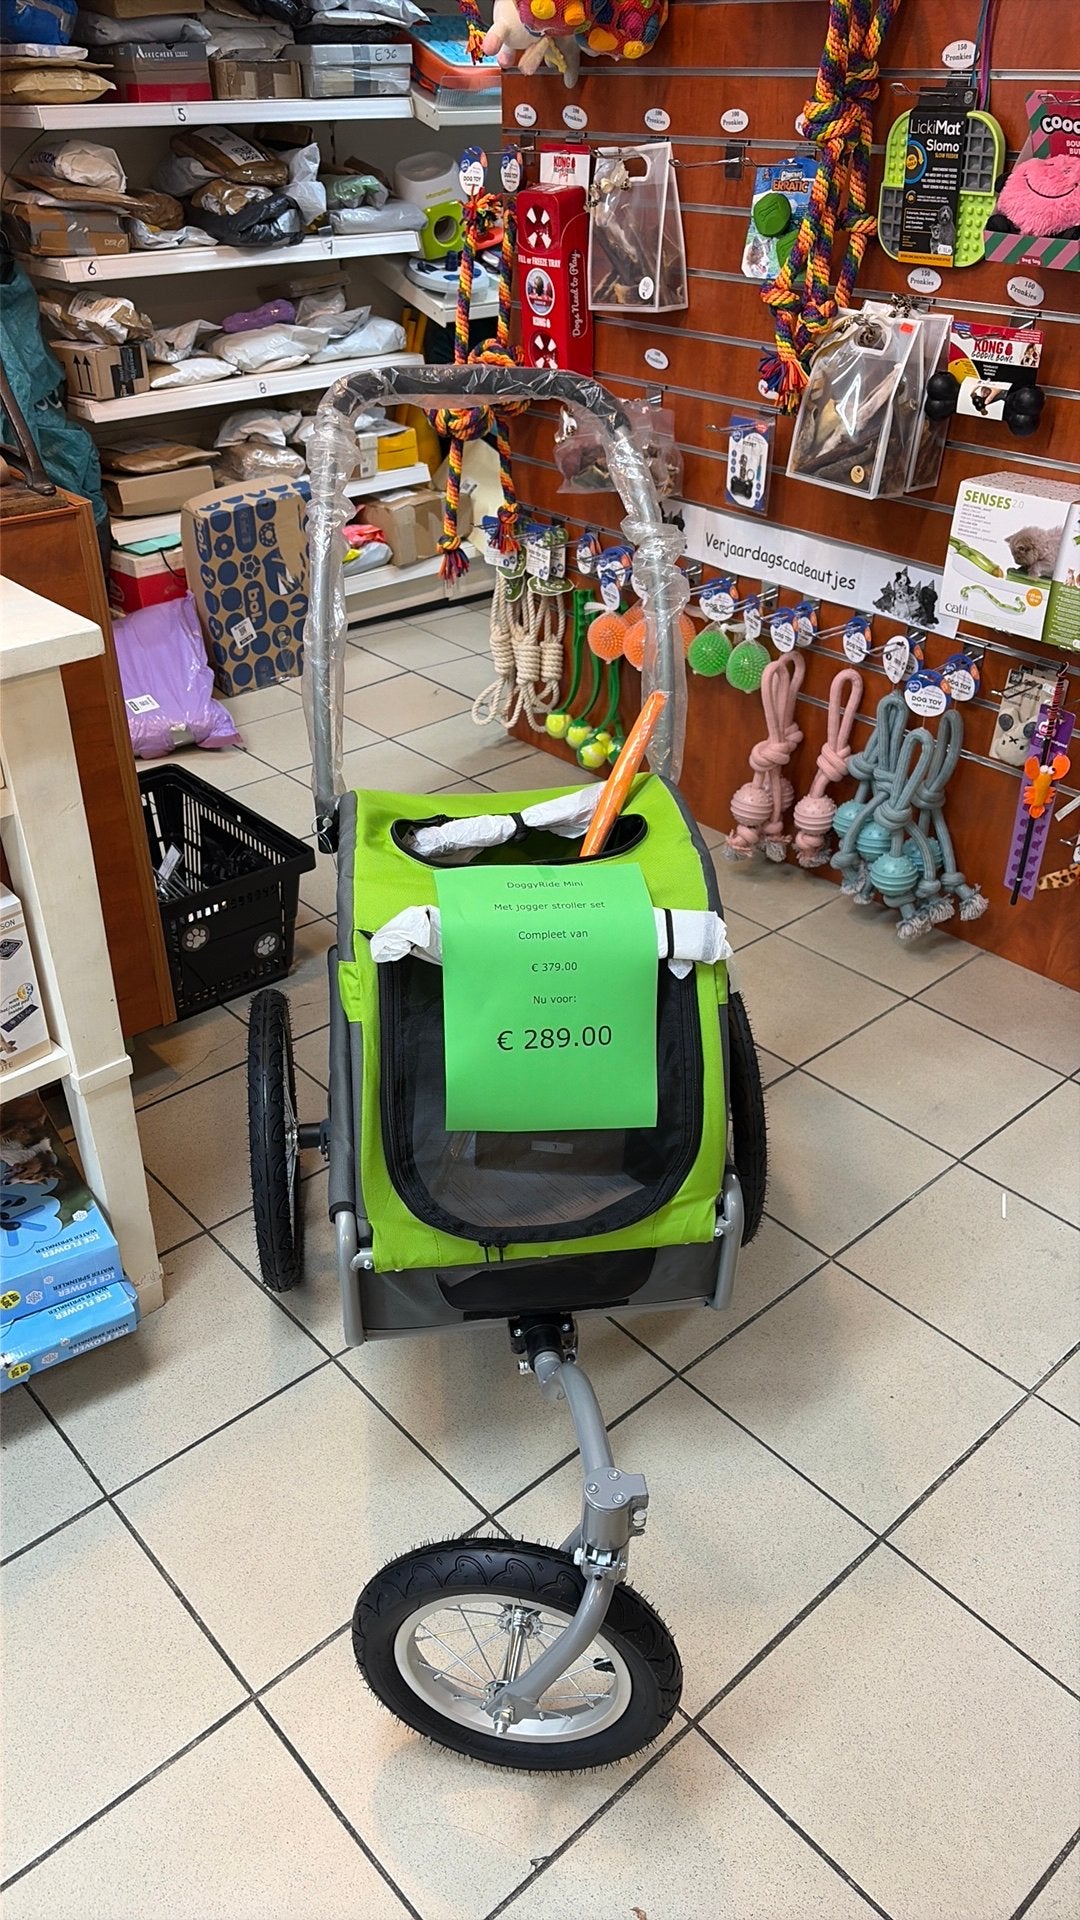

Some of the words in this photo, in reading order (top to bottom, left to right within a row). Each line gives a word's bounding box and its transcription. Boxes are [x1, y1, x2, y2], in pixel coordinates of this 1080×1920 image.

[375, 48, 397, 61] E36
[945, 53, 971, 61] Pronkies
[178, 107, 187, 122] 5
[647, 116, 665, 125] Pronkies
[910, 119, 961, 136] LickiMat
[926, 139, 959, 152] Slomo
[554, 156, 570, 168] KONG
[771, 179, 809, 193] ERRATIC
[324, 240, 333, 255] 7
[88, 261, 97, 276] 6
[571, 276, 578, 288] to
[910, 277, 934, 286] Pronkies
[1024, 280, 1035, 289] 150
[1010, 284, 1037, 301] Pronkies
[570, 288, 579, 313] Need
[572, 313, 583, 337] Dogs
[975, 340, 1004, 354] KONG
[971, 350, 995, 360] GOODIE
[259, 381, 267, 394] 8
[964, 490, 1012, 509] SENSES
[706, 532, 856, 590] Verjaardagscadeautjes
[248, 588, 262, 623] bol.
[945, 602, 968, 616] catit
[929, 698, 942, 706] TOY
[507, 881, 560, 889] DoggyRide
[494, 903, 513, 911] Met
[516, 903, 549, 912] jogger
[552, 901, 587, 910] stroller
[590, 901, 605, 909] set
[518, 930, 567, 941] Compleet
[570, 930, 588, 938] van
[531, 963, 538, 972] €
[542, 962, 578, 972] 379.00
[533, 995, 547, 1004] Nu
[550, 994, 577, 1003] voor:
[497, 1030, 514, 1050] €
[524, 1025, 612, 1050] 289.00
[75, 1228, 97, 1240] WATER
[82, 1233, 100, 1245] ICE
[35, 1237, 73, 1254] SPRINKLER
[41, 1239, 81, 1259] FLOWER
[91, 1266, 114, 1277] WATER
[98, 1272, 116, 1284] ICE
[52, 1274, 91, 1292] SPRINKLER
[56, 1277, 97, 1298] FLOWER
[86, 1286, 108, 1299] WATER
[95, 1291, 113, 1302] ICE
[47, 1297, 85, 1316] SPRINKLER
[54, 1299, 95, 1321] FLOWER
[106, 1322, 129, 1335] WATER
[112, 1328, 130, 1339] ICE
[68, 1332, 105, 1351] SPRINKLER
[72, 1334, 111, 1354] FLOWER
